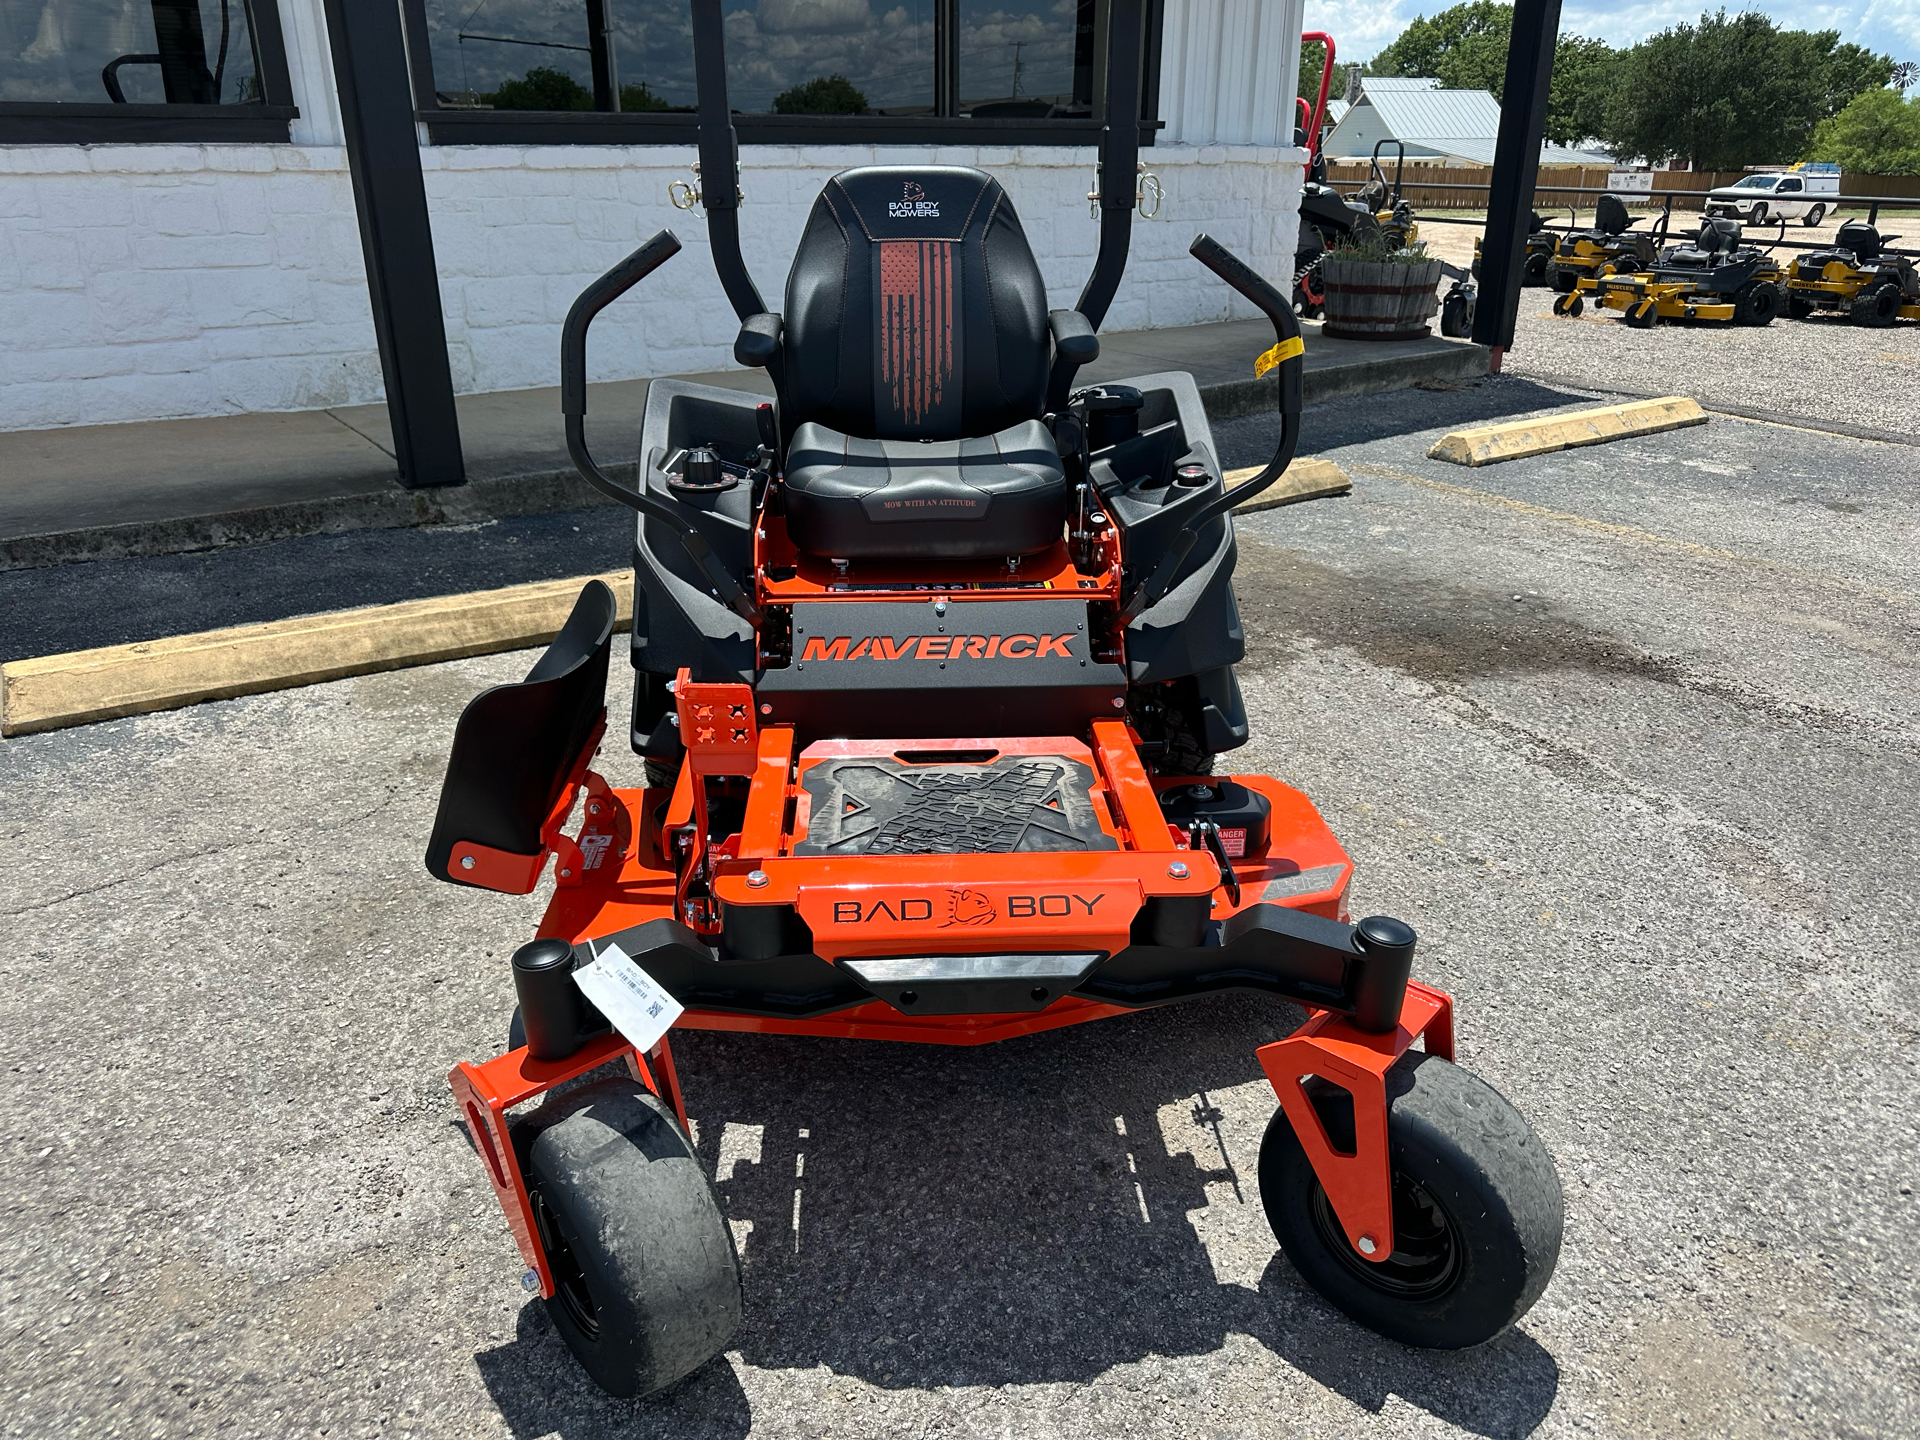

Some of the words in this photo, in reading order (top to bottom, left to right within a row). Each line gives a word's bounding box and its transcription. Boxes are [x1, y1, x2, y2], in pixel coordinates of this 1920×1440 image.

[889, 202, 912, 210] BAD
[889, 210, 940, 218] MOWERS
[1606, 283, 1635, 292] HUSTLER
[883, 501, 903, 509] MOW
[938, 499, 977, 507] ATTITUDE
[801, 633, 1078, 661] MAVERICK
[1217, 830, 1244, 838] ANGER
[833, 899, 932, 923] BAD
[1008, 893, 1106, 918] BOY
[626, 966, 638, 978] BAD
[640, 979, 652, 990] BOY
